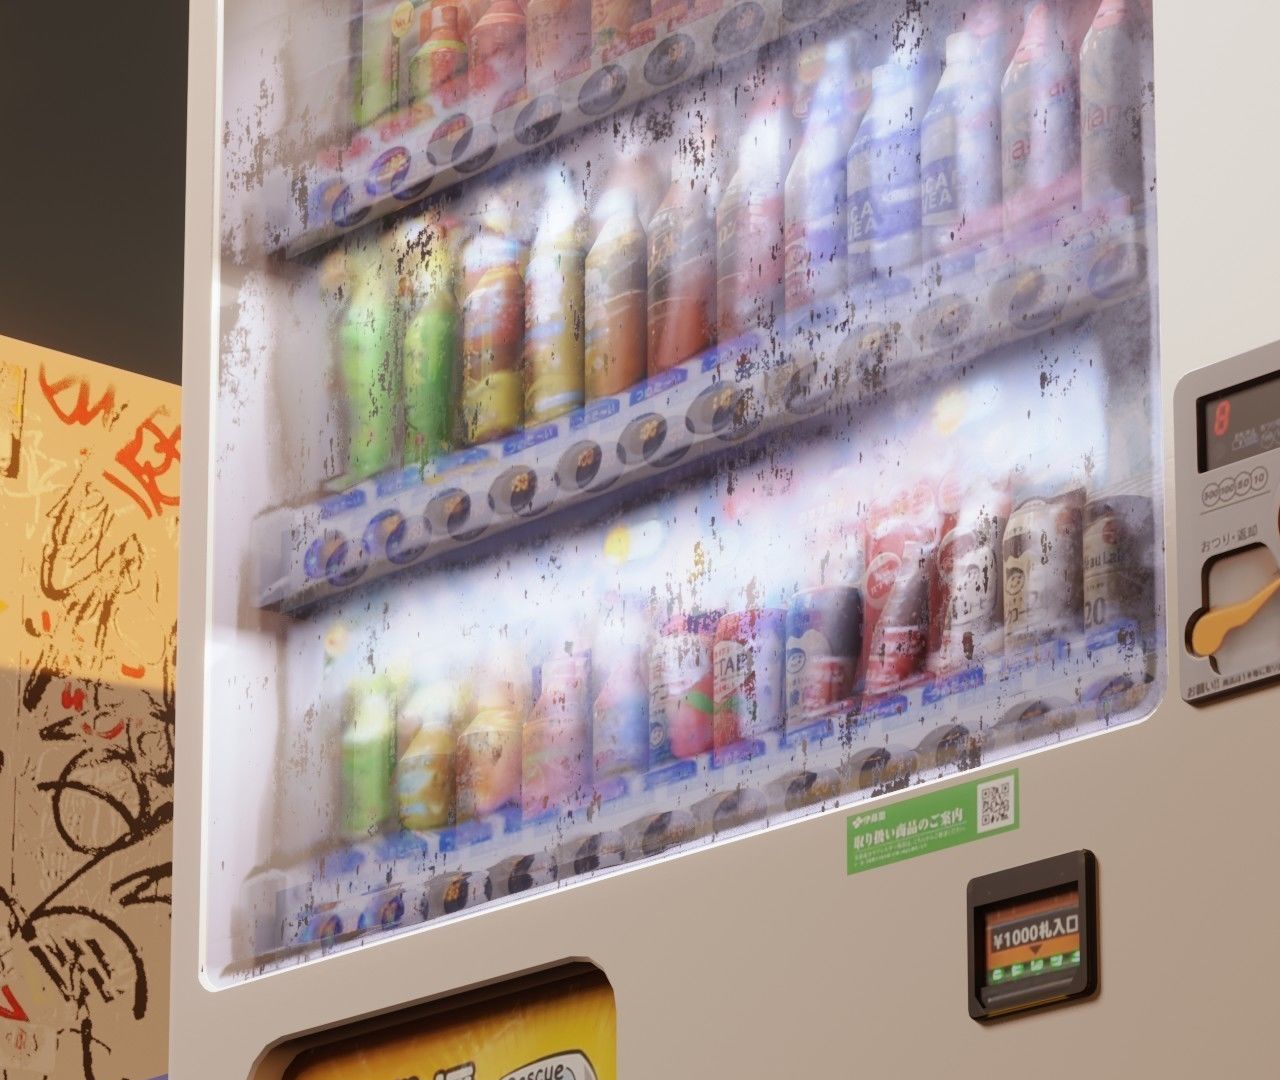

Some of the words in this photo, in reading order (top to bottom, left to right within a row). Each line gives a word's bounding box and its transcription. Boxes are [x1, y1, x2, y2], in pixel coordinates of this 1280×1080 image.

[1253, 471, 1265, 484] 10
[1201, 525, 1258, 554] おつり・返却
[853, 807, 963, 850] 取り扱い商品のご案内
[993, 914, 1079, 950] ¥1000札入口
